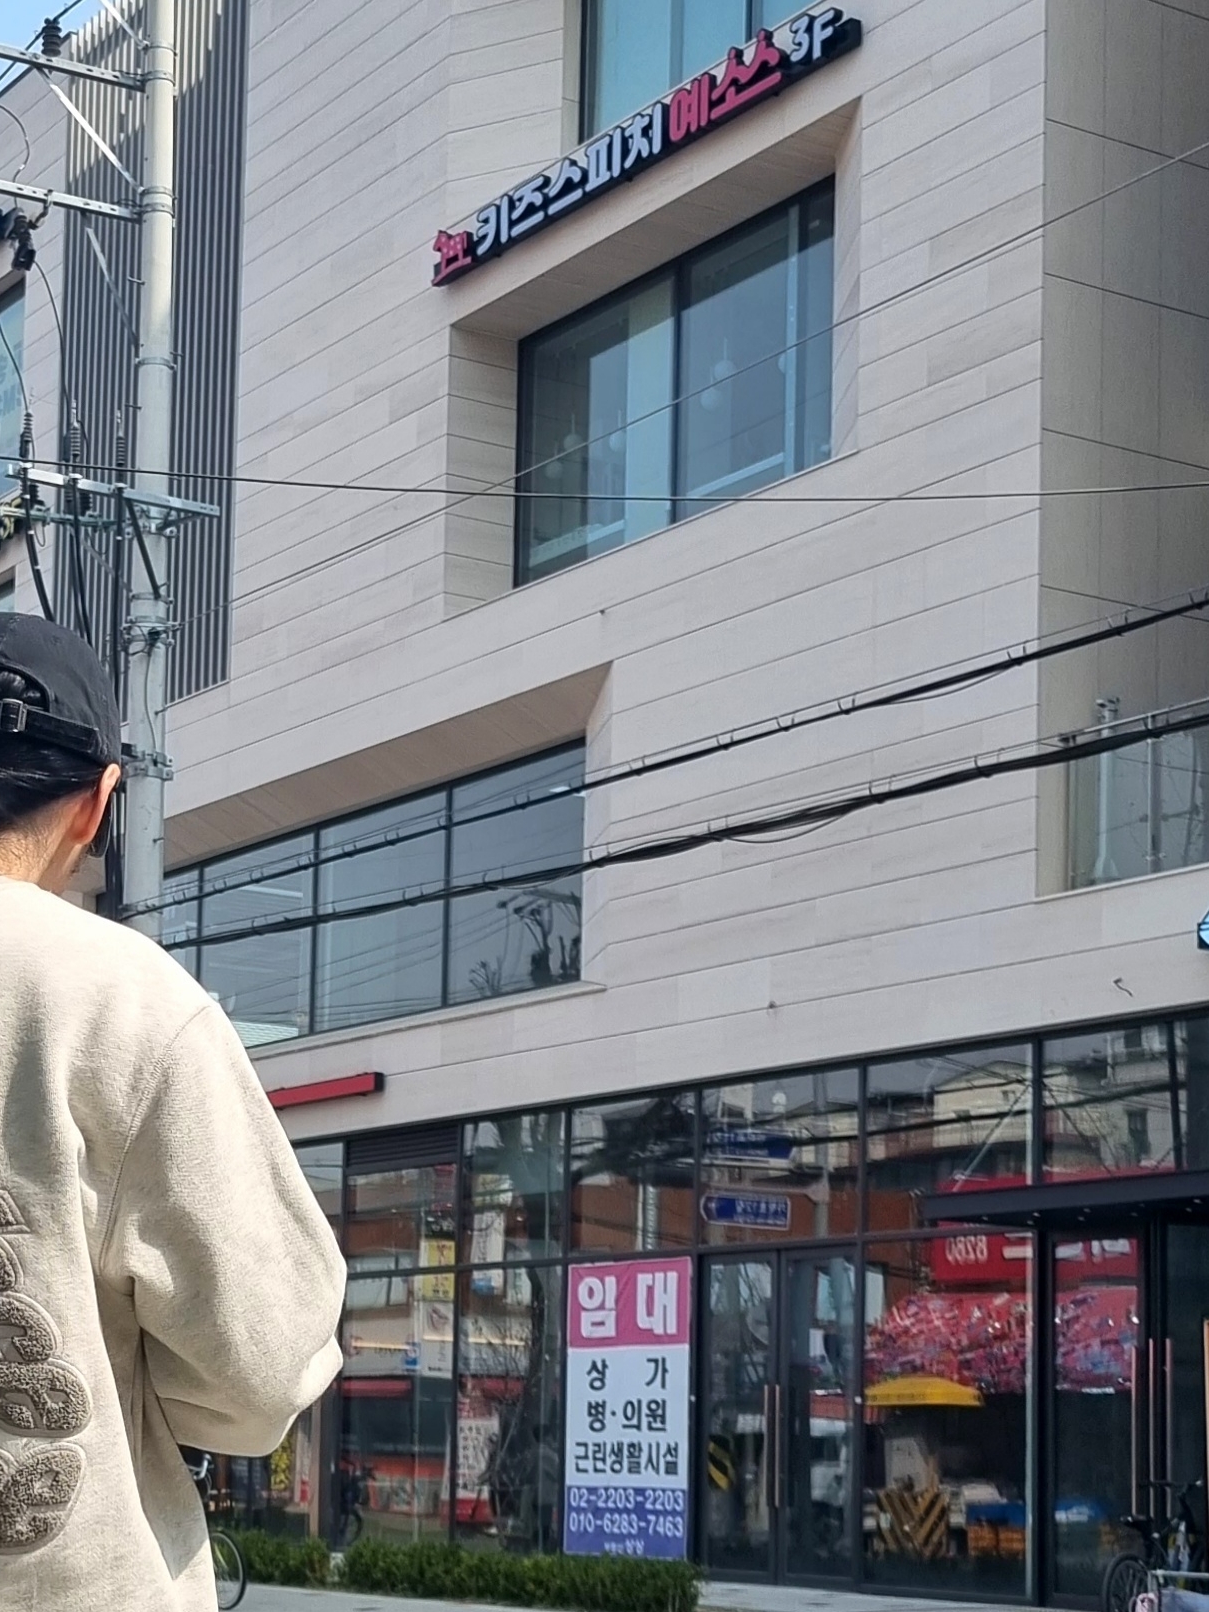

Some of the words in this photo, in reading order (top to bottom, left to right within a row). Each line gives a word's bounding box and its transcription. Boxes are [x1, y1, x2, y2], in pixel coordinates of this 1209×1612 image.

[476, 103, 662, 257] 키즈스피치
[789, 8, 837, 63] 3F
[577, 1271, 678, 1338] 임대
[586, 1356, 668, 1392] 상가
[587, 1398, 667, 1433] 병·의원
[575, 1441, 680, 1476] 근린생활시설
[569, 1487, 684, 1511] 02-2203-2203
[569, 1511, 684, 1538] 010-6283-7463
